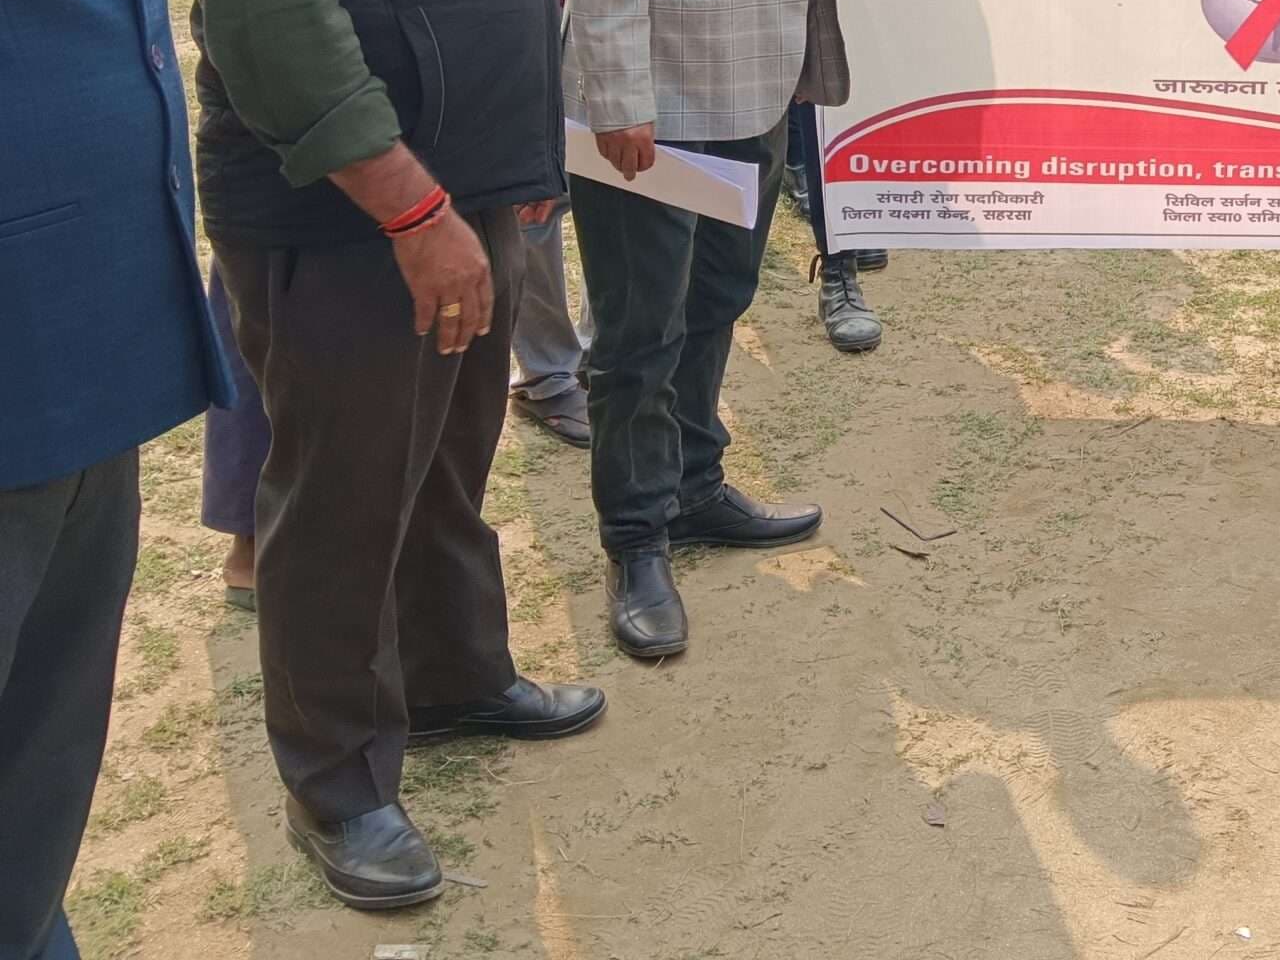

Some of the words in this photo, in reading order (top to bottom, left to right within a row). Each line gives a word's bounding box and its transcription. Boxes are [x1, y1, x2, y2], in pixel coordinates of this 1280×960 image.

[1152, 79, 1268, 96] जारूकता
[849, 154, 1030, 179] Overcoming
[1041, 156, 1203, 180] disruption,
[876, 190, 924, 204] संचारी
[930, 190, 958, 204] रोग
[965, 190, 1045, 205] पदाधिकारी
[1165, 193, 1214, 207] सिविल
[1220, 194, 1262, 208] सर्जन
[842, 206, 883, 220] जिला
[888, 209, 930, 220] यक्ष्मा
[936, 207, 976, 222] केन्द्र,
[983, 209, 1032, 221] सहरसा
[1163, 208, 1202, 222] जिला
